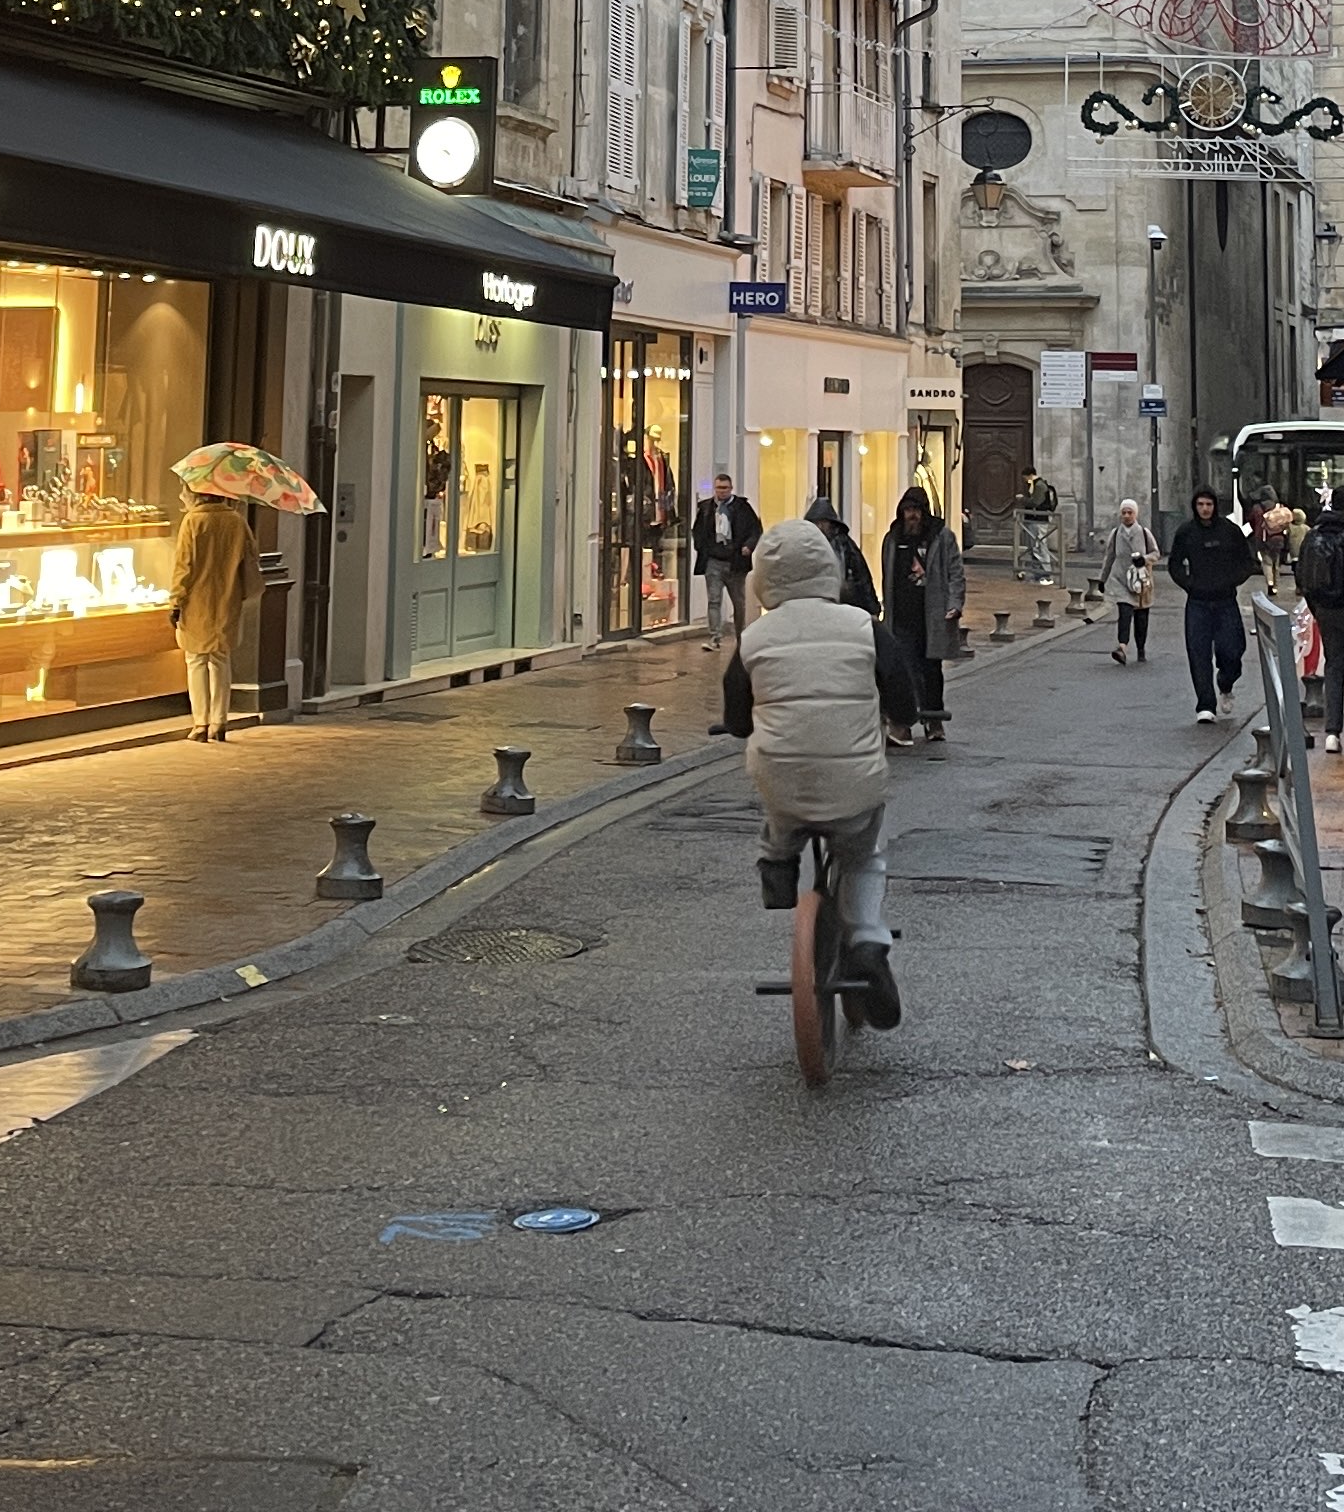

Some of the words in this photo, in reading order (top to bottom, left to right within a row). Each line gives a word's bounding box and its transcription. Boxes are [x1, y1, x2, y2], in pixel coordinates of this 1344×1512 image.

[420, 88, 481, 104] ROLEX
[689, 174, 716, 183] LOUER
[253, 225, 316, 276] DOUX
[732, 292, 780, 306] HERO
[909, 389, 956, 397] SANDRO
